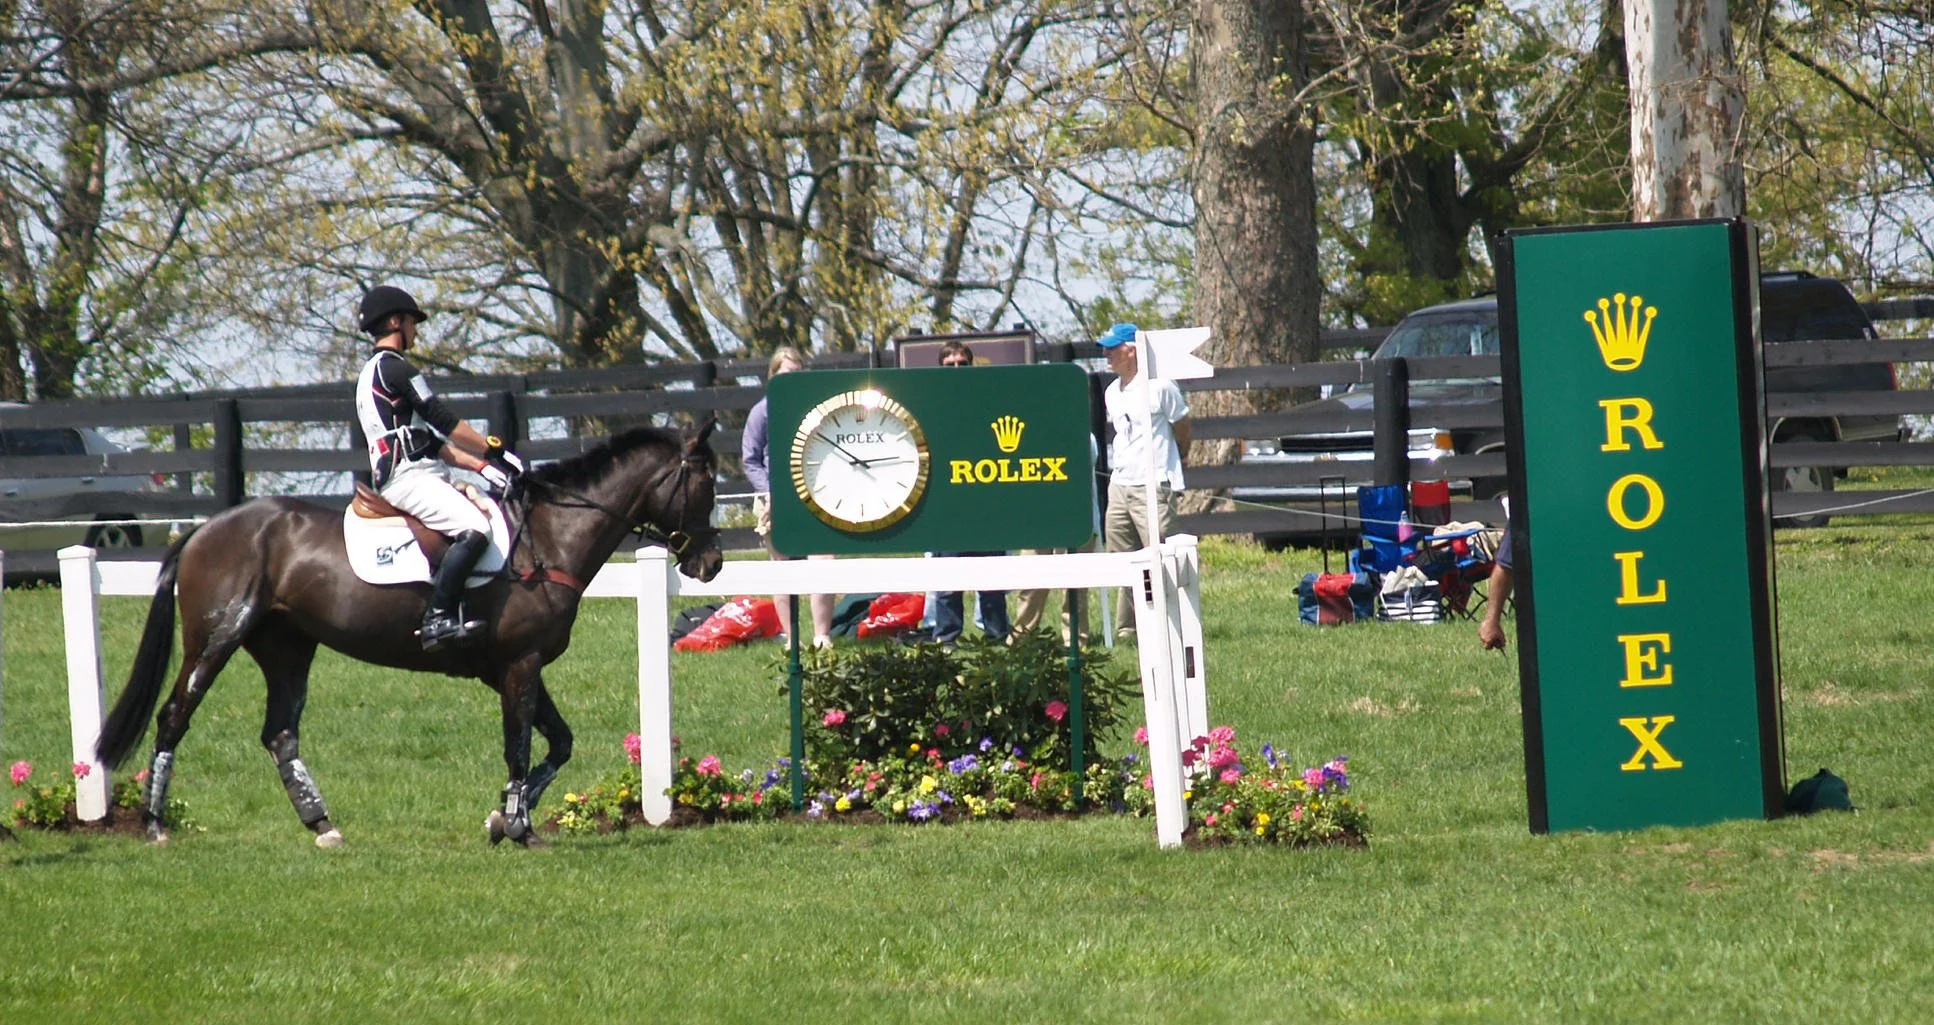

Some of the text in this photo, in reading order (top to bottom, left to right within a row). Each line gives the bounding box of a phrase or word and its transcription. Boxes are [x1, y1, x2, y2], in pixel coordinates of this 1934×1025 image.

[836, 432, 884, 444] ROLEX
[950, 457, 1068, 484] ROLEX
[1599, 397, 1683, 771] ROLEX
